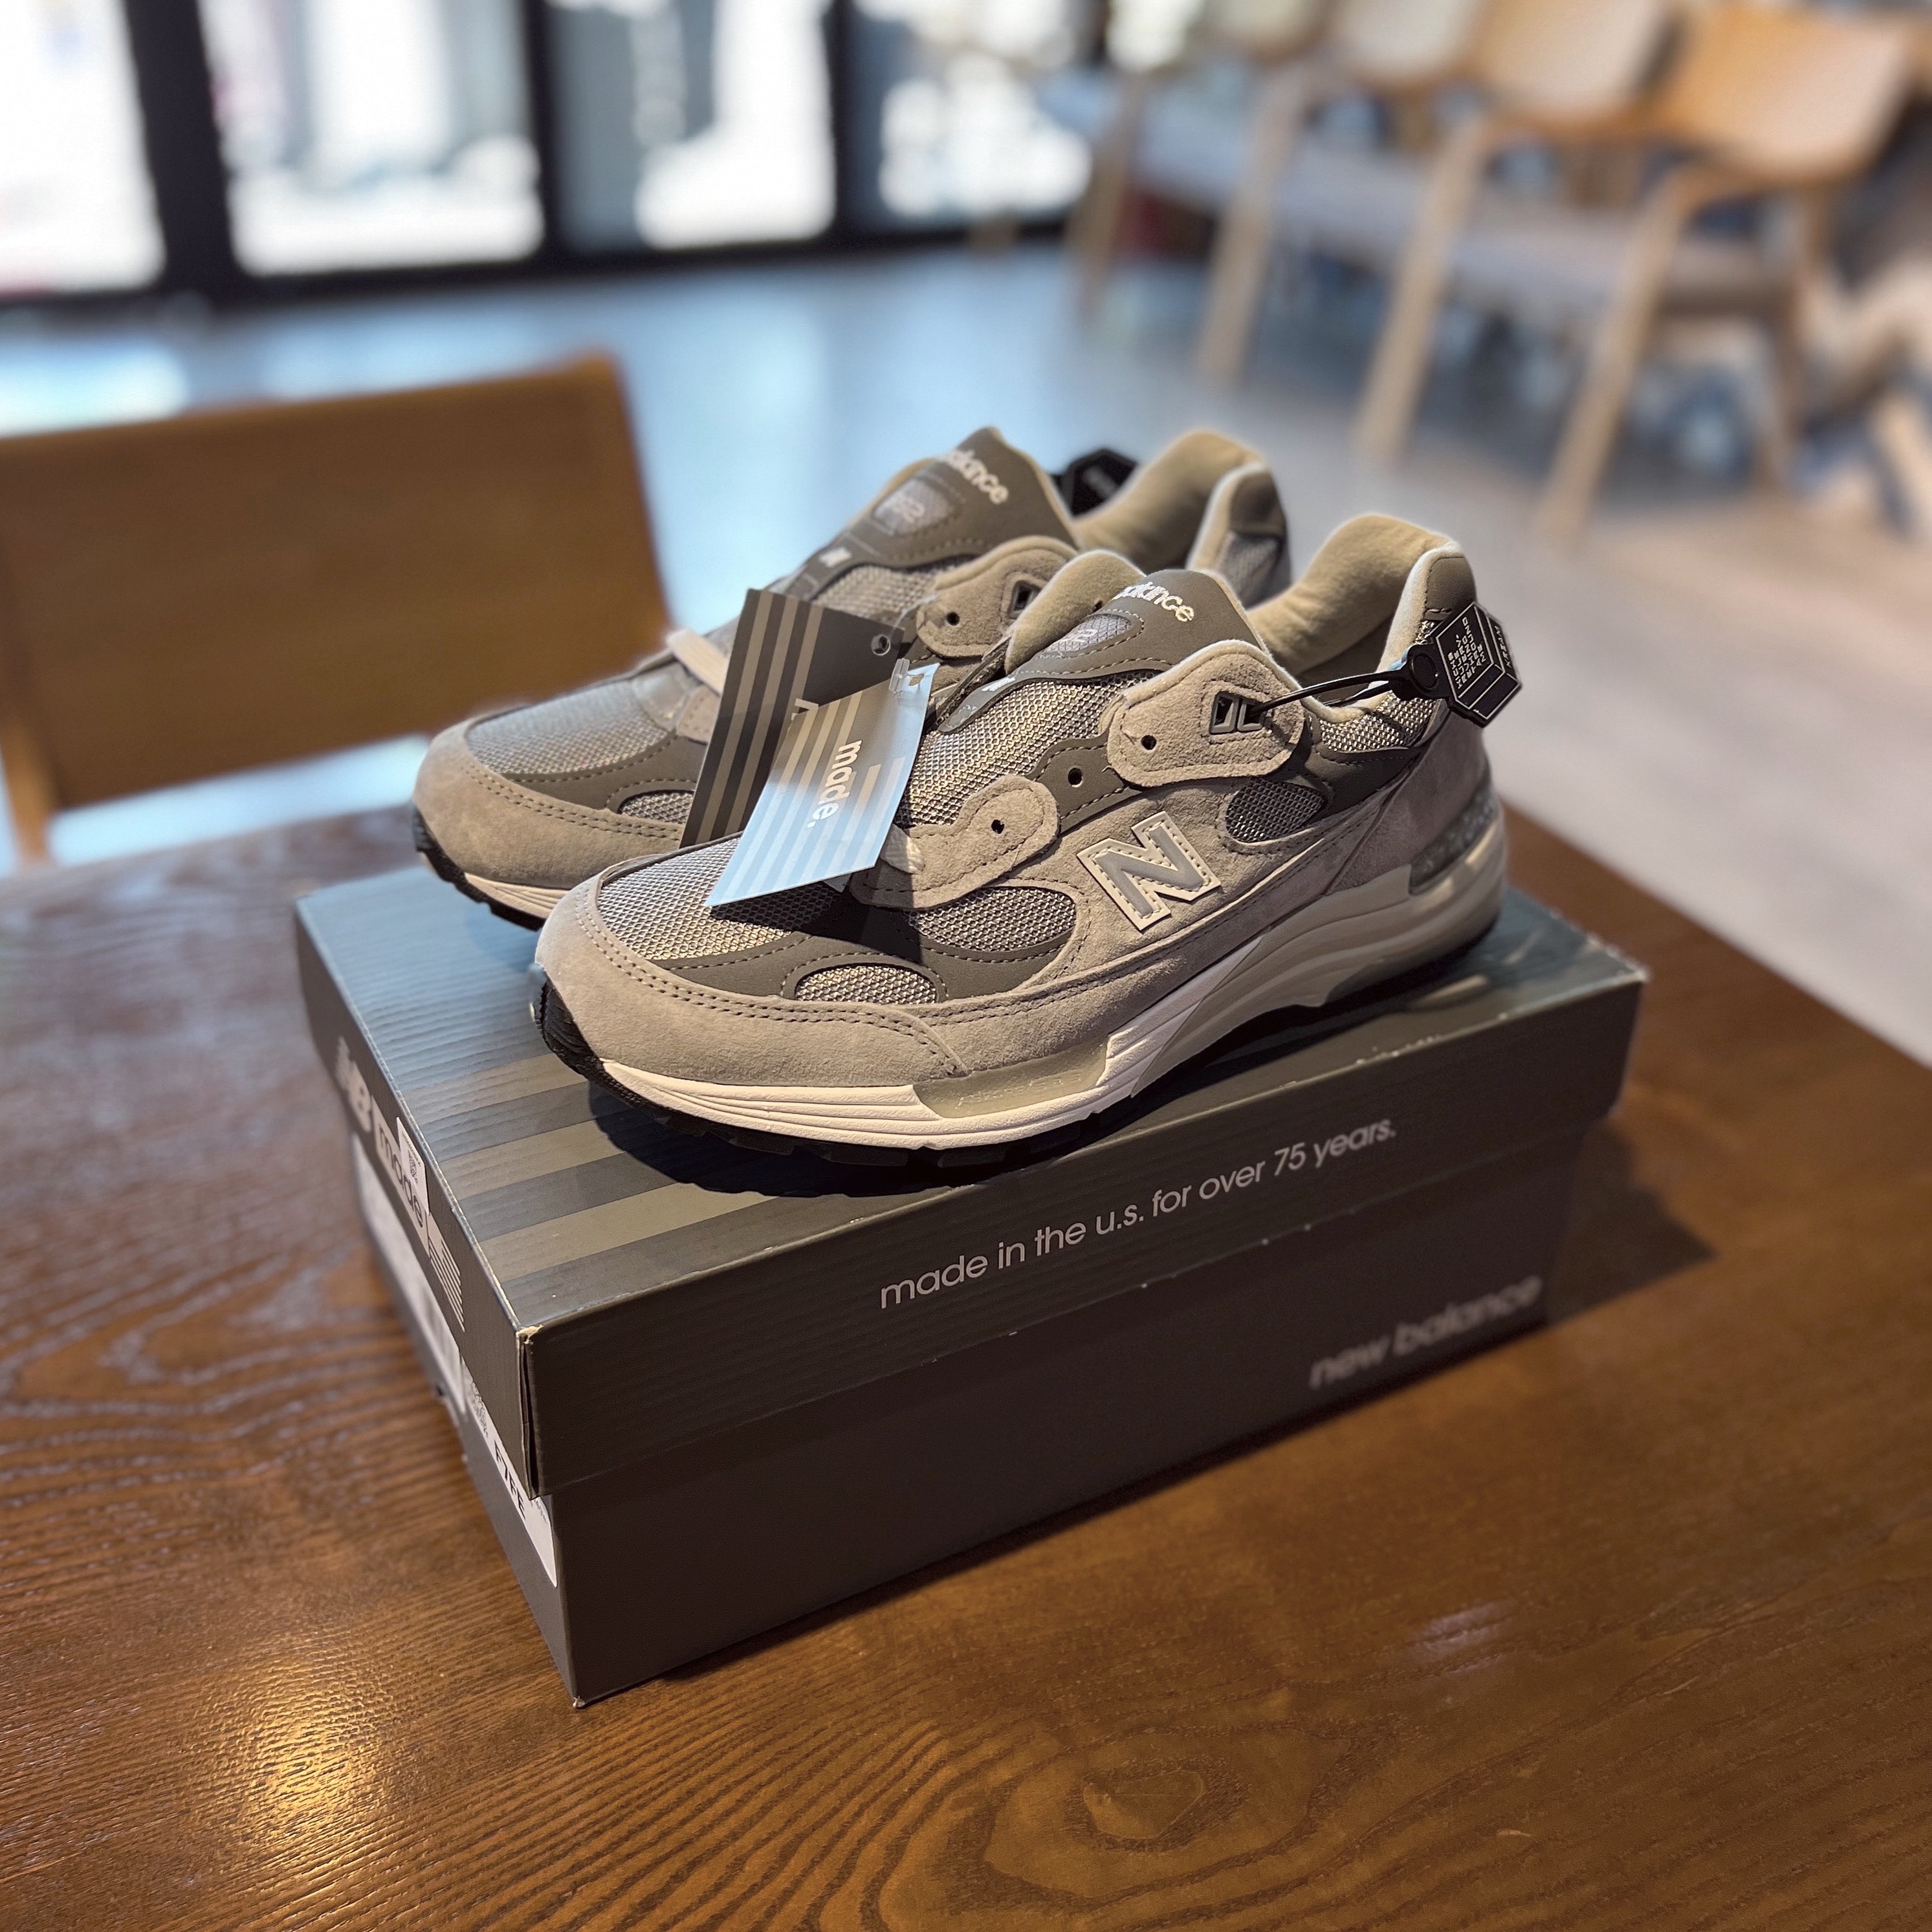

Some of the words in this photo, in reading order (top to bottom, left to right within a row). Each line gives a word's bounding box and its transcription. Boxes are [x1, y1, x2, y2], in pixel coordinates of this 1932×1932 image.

[1456, 634, 1472, 679] EVERY-
[1462, 617, 1482, 666] AROUND
[1463, 635, 1476, 674] THING
[1477, 644, 1486, 663] ME
[1494, 625, 1512, 668] KREAM
[1447, 652, 1463, 690] KICKS
[1454, 652, 1467, 684] RULE
[807, 740, 862, 828] made.
[1077, 811, 1222, 931] N
[881, 1254, 989, 1310] made
[998, 1241, 1026, 1270] in
[1034, 1222, 1087, 1257] the
[1096, 1204, 1145, 1235] u.s.
[1152, 1184, 1192, 1218] for
[1199, 1160, 1266, 1200] over
[1275, 1141, 1306, 1176] 75
[1313, 1118, 1397, 1168] years.
